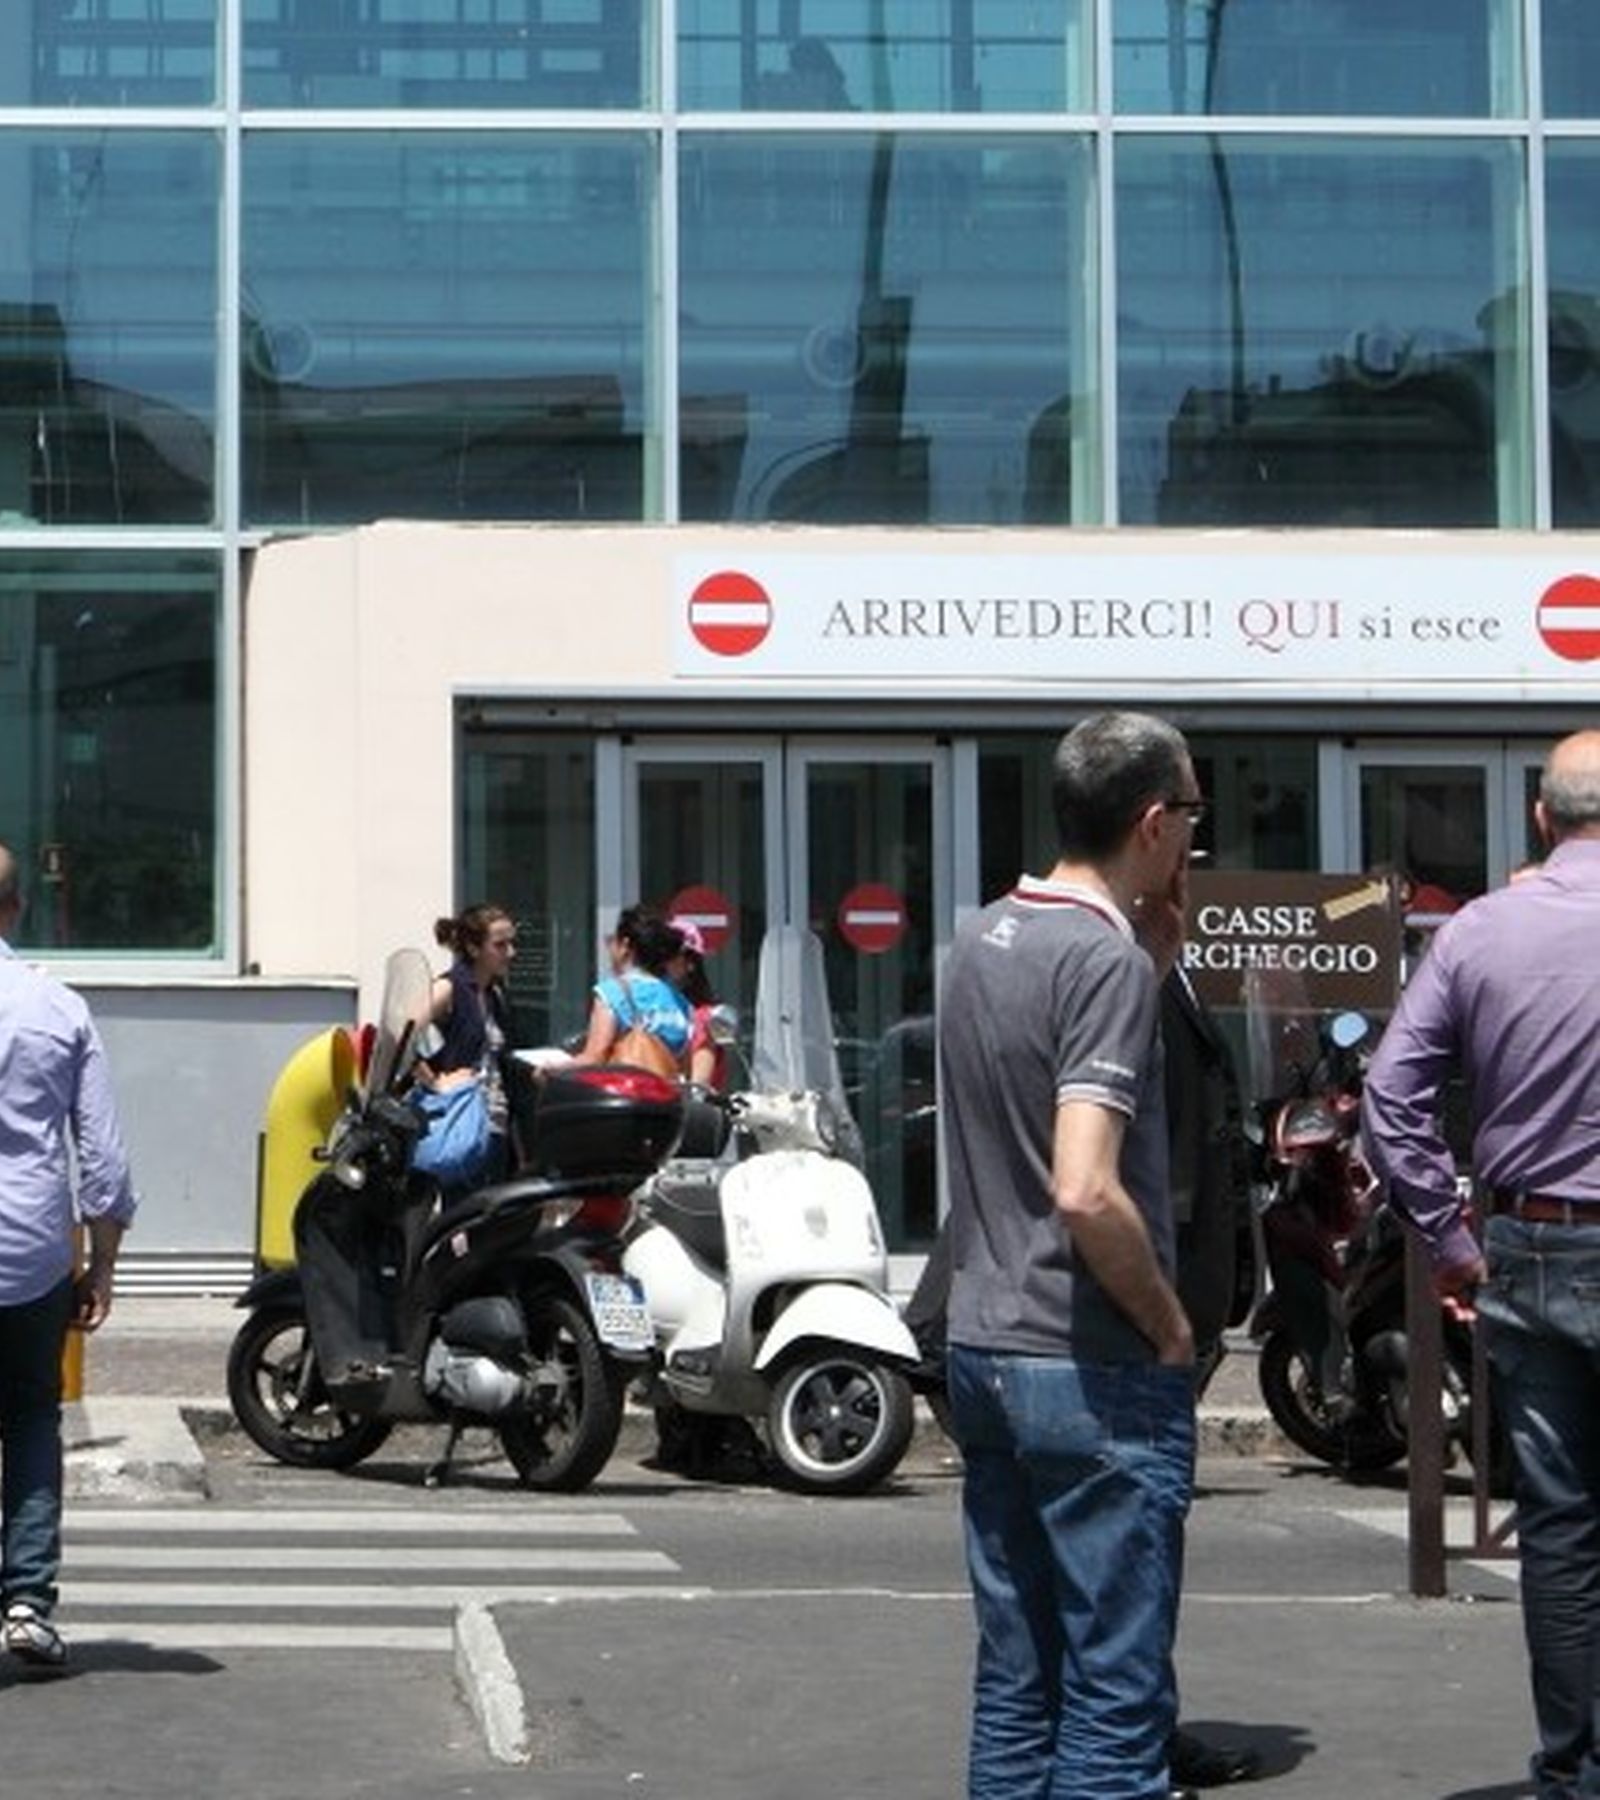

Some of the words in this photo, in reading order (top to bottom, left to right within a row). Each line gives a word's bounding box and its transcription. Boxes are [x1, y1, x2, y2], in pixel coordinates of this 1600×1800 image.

[822, 598, 1213, 639] ARRIVEDERCI!
[1237, 598, 1340, 653] QUI
[1358, 605, 1393, 640] si
[1411, 616, 1501, 641] esce
[1197, 905, 1318, 936] CASSE
[1183, 942, 1379, 973] RCHEGGIO
